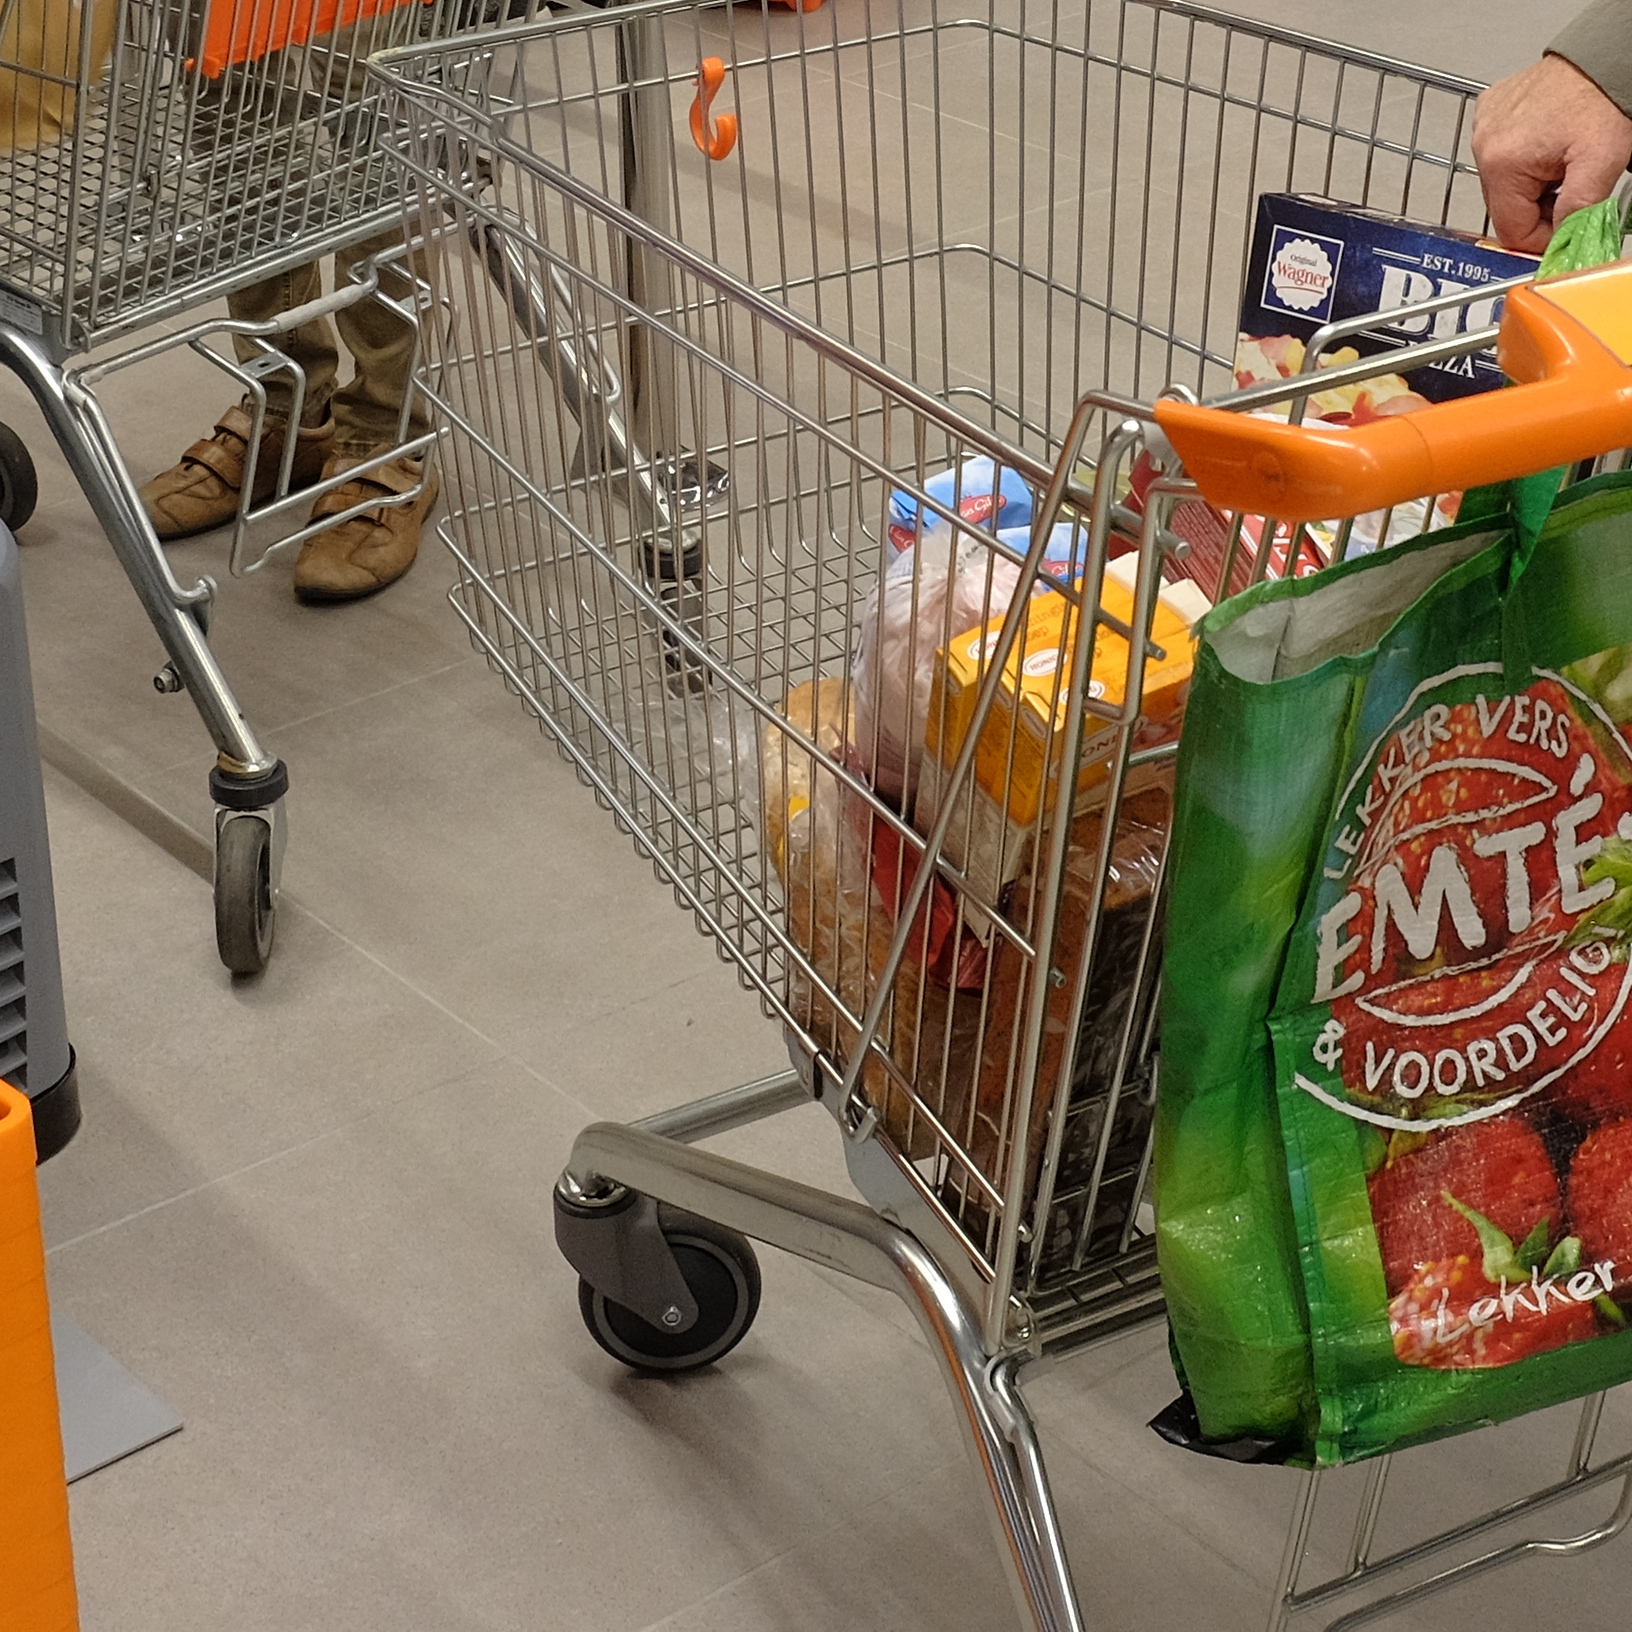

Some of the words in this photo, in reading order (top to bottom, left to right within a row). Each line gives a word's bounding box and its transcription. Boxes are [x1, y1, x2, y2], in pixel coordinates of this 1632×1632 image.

[1276, 260, 1330, 289] Wagner
[1290, 252, 1318, 268] Original
[1420, 253, 1491, 284] EST.1995
[1323, 703, 1452, 880] LEKKER
[1475, 693, 1571, 759] VERS
[1312, 1018, 1347, 1071] &
[1364, 926, 1625, 1100] VOORDELIG
[1433, 1256, 1618, 1348] Lekker
